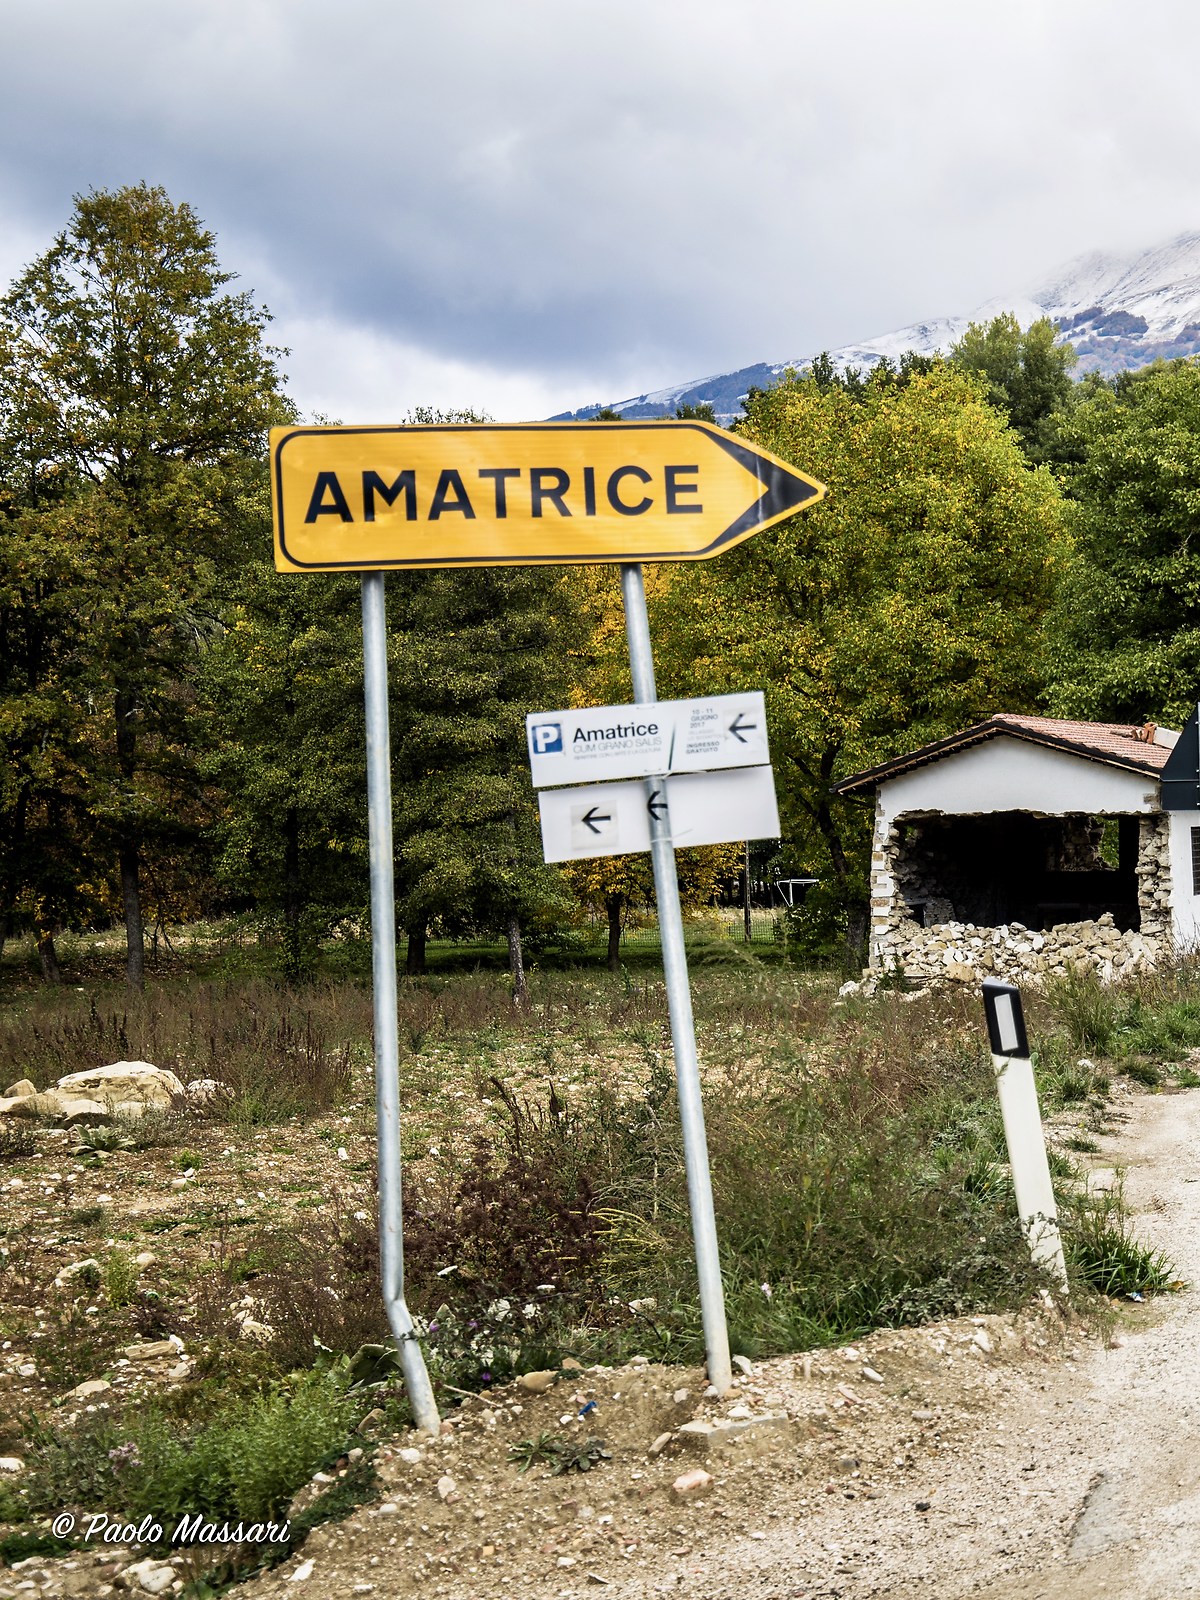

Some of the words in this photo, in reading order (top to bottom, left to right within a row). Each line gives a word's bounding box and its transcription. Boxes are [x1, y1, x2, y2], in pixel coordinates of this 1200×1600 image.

[304, 464, 703, 524] AMATRICE
[690, 714, 719, 722] GIUGNO
[536, 726, 558, 752] P
[573, 722, 659, 743] Amatrice
[573, 743, 596, 754] CUM
[598, 739, 634, 752] GRANO
[635, 736, 662, 748] SALIS
[685, 747, 719, 755] GRATUITO
[686, 741, 720, 749] INGRESSO
